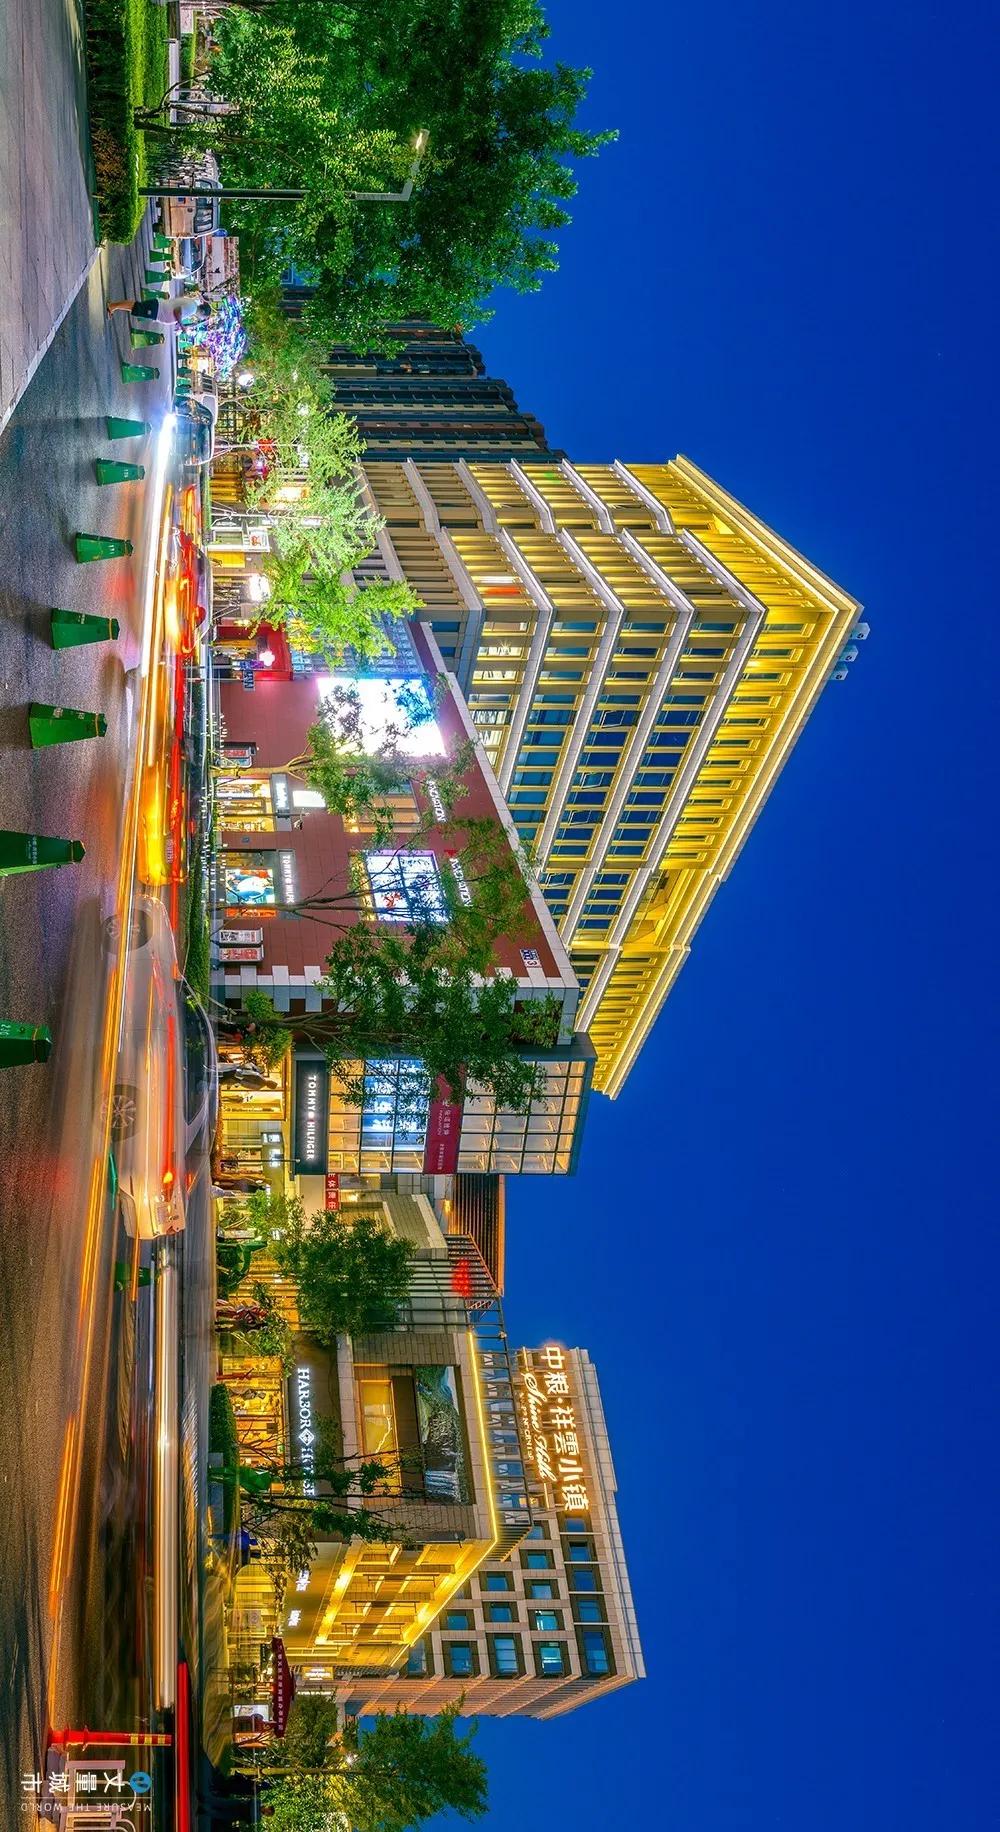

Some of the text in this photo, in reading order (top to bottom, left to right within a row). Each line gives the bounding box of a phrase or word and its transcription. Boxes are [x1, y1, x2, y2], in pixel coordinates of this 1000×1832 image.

[282, 855, 292, 879] TOMMY
[306, 1075, 317, 1160] TOMMY HILFIGER
[521, 1372, 557, 1482] Shine Hills
[540, 1346, 589, 1513] 中粮·祥雲小镇
